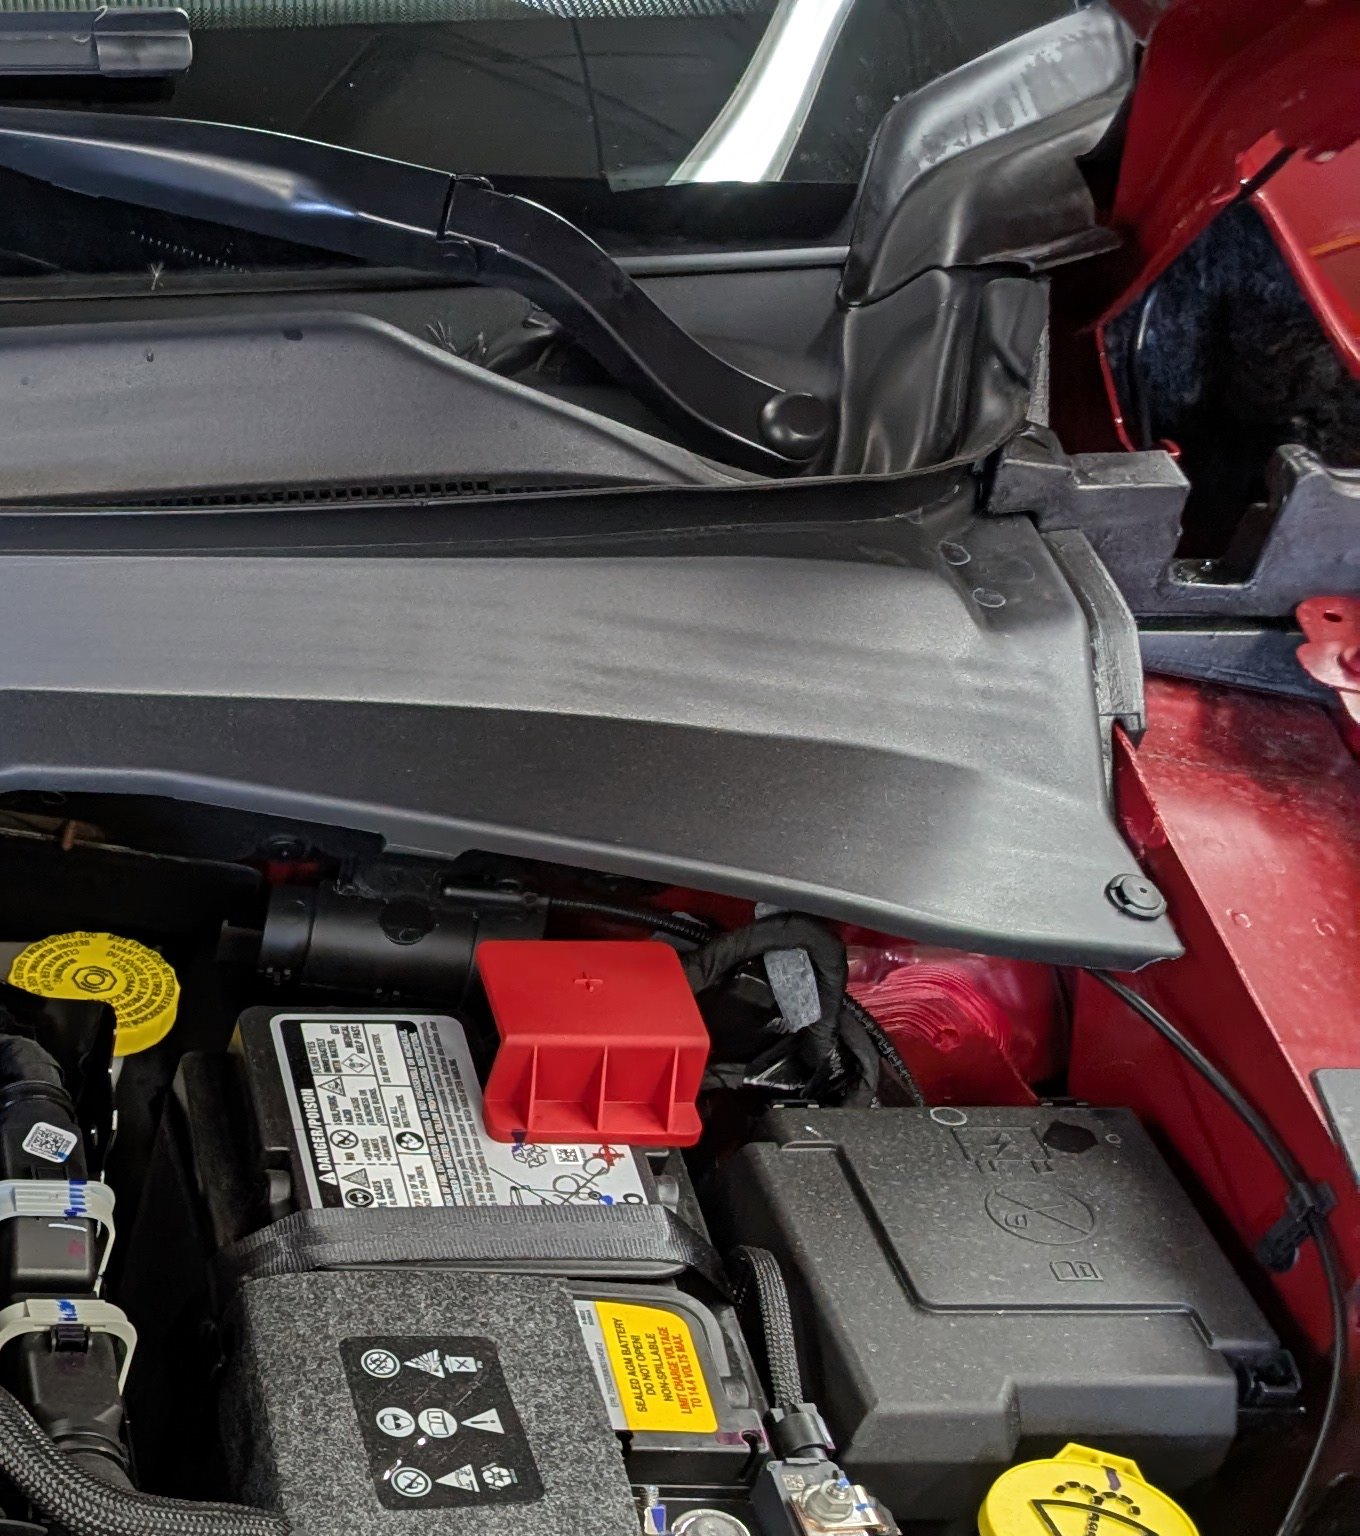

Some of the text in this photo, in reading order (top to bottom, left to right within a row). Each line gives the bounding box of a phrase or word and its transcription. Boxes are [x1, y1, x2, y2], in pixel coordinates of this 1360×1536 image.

[329, 1024, 340, 1034] GET
[326, 1094, 342, 1122] SULFURIC
[341, 1108, 353, 1122] ACID
[349, 1096, 364, 1122] CAN CAUSE
[306, 1088, 333, 1172] DANGER/POISON
[344, 1151, 355, 1160] NO
[371, 1180, 385, 1200] GASES
[611, 1317, 647, 1411] SEALED AGM BATTERY
[637, 1363, 651, 1380] NOT
[644, 1333, 674, 1401] NON-SPILLABLE
[656, 1326, 692, 1413] LIMIT CHARGE VOLTAGE
[676, 1354, 694, 1377] VOLTS
[643, 1383, 656, 1395] DO
[684, 1380, 699, 1394] 14.4
[689, 1398, 702, 1407] TO
